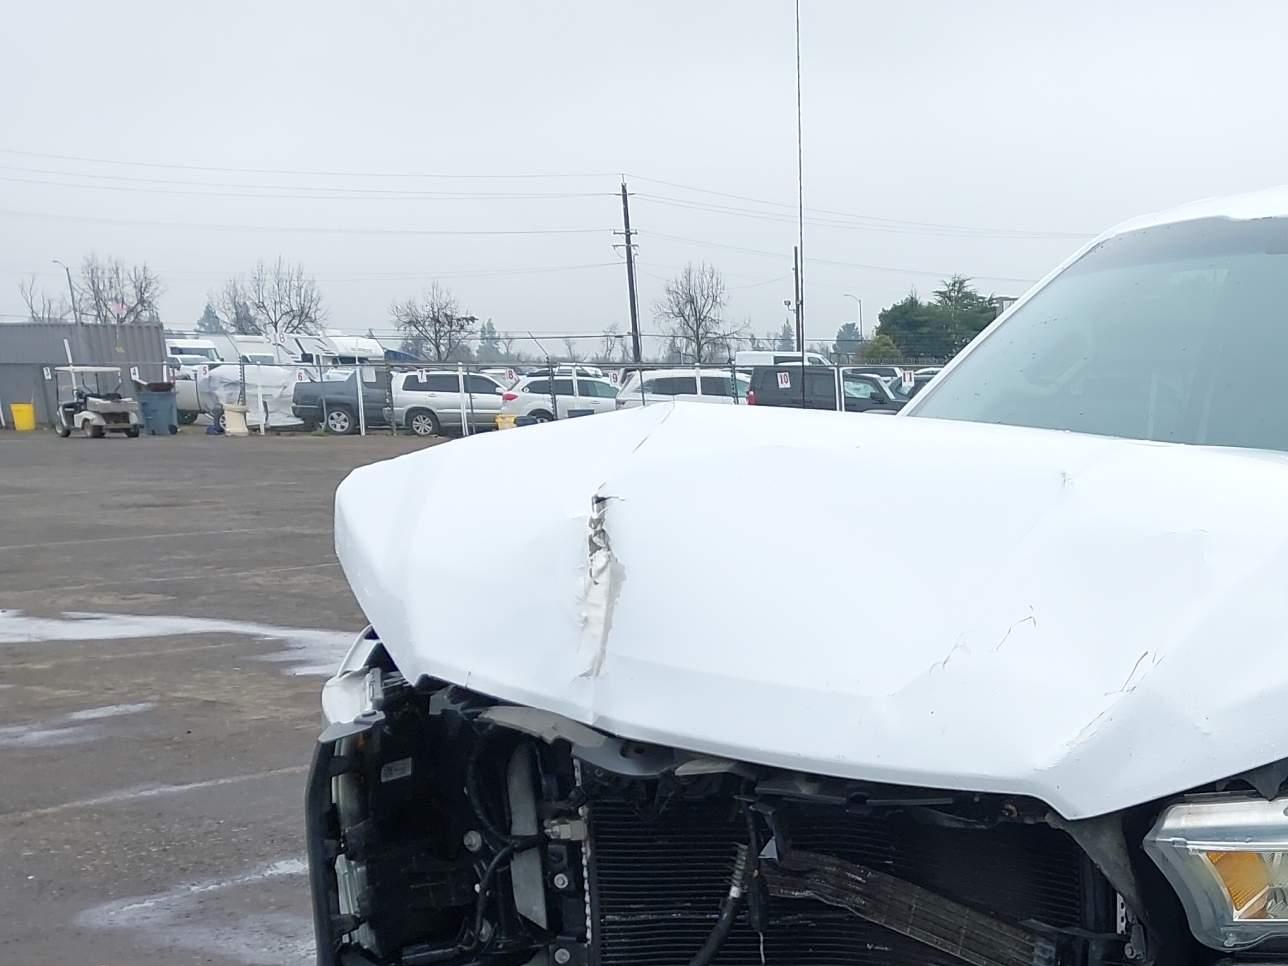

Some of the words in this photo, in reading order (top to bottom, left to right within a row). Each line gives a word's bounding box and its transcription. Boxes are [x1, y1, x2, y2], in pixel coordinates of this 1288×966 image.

[202, 367, 208, 375] 5
[297, 372, 303, 380] 6
[779, 373, 789, 385] 10
